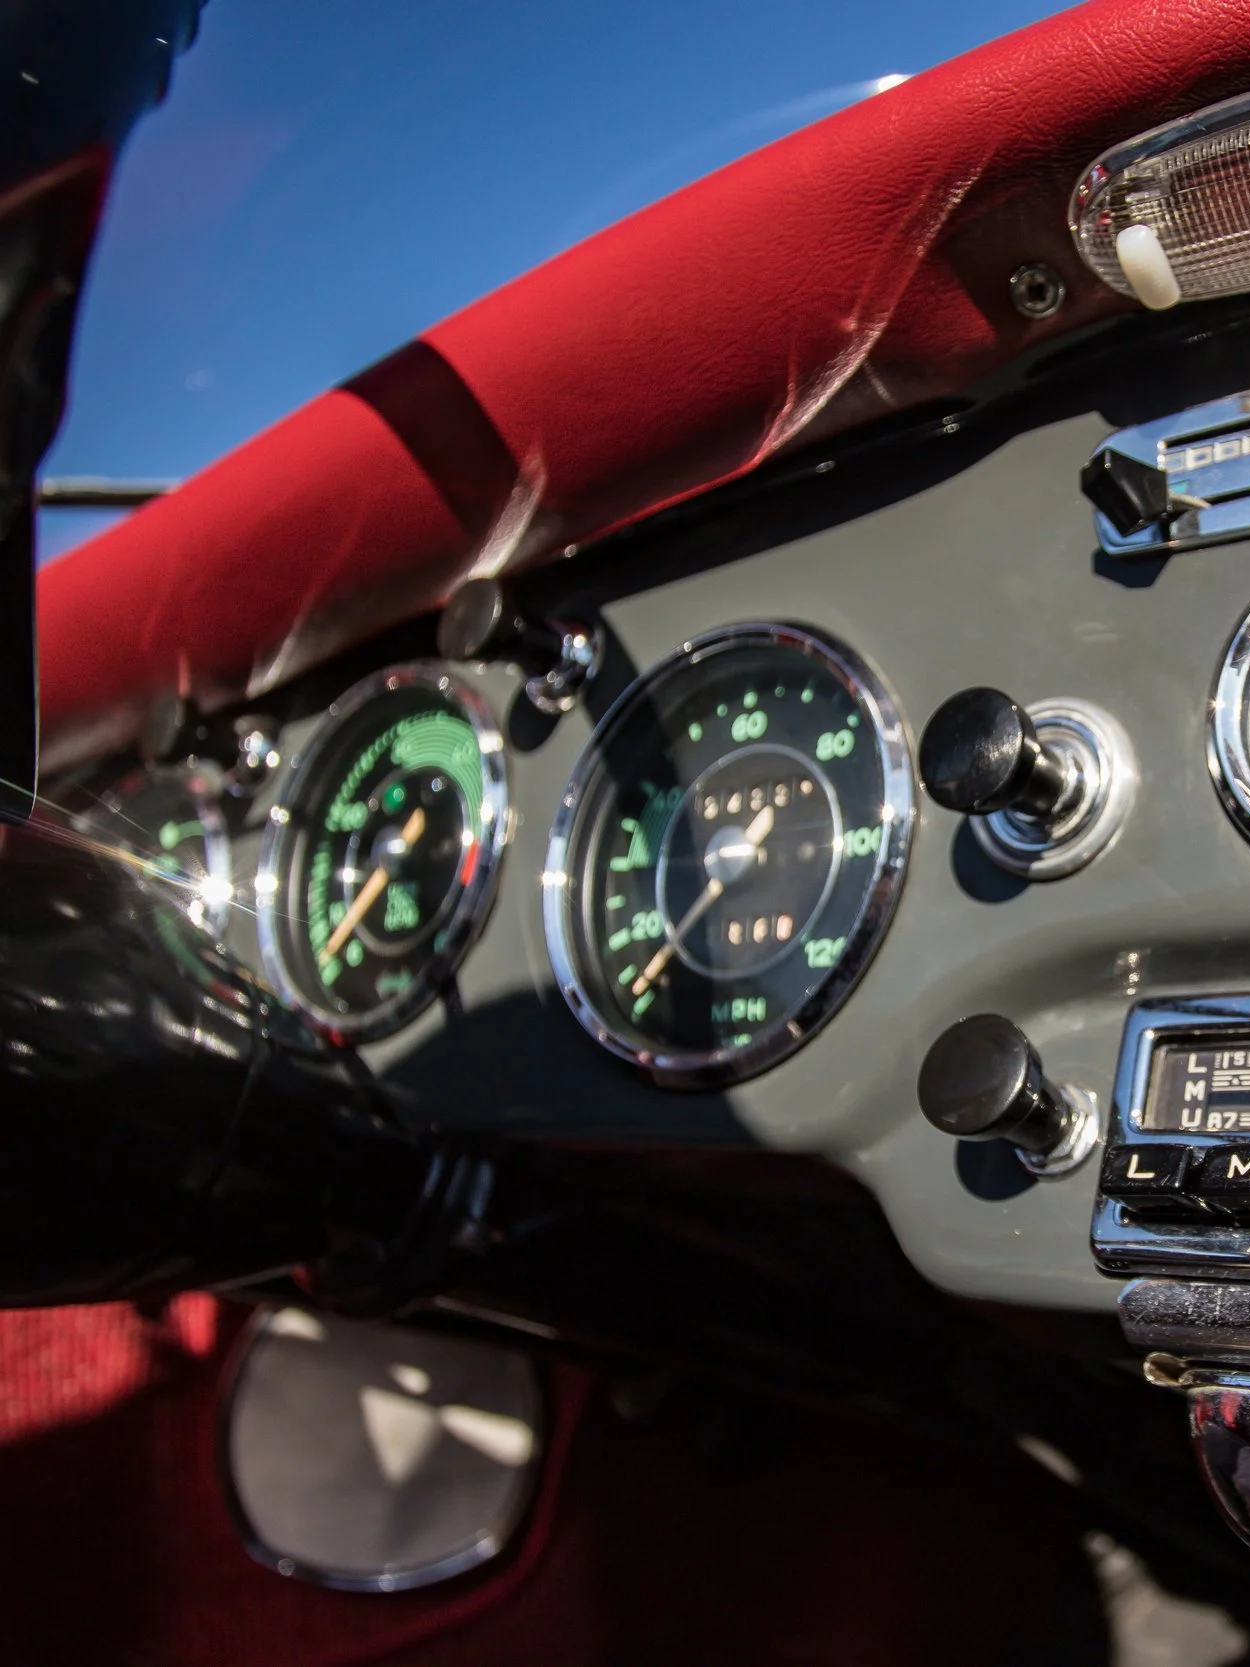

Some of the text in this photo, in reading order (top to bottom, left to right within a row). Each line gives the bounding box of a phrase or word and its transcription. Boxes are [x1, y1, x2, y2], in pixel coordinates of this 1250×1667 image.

[631, 909, 663, 941] 20
[711, 997, 766, 1022] MPH
[1188, 1053, 1207, 1073] L
[1184, 1080, 1206, 1102] M
[1182, 1108, 1202, 1127] U
[1126, 1154, 1155, 1179] L
